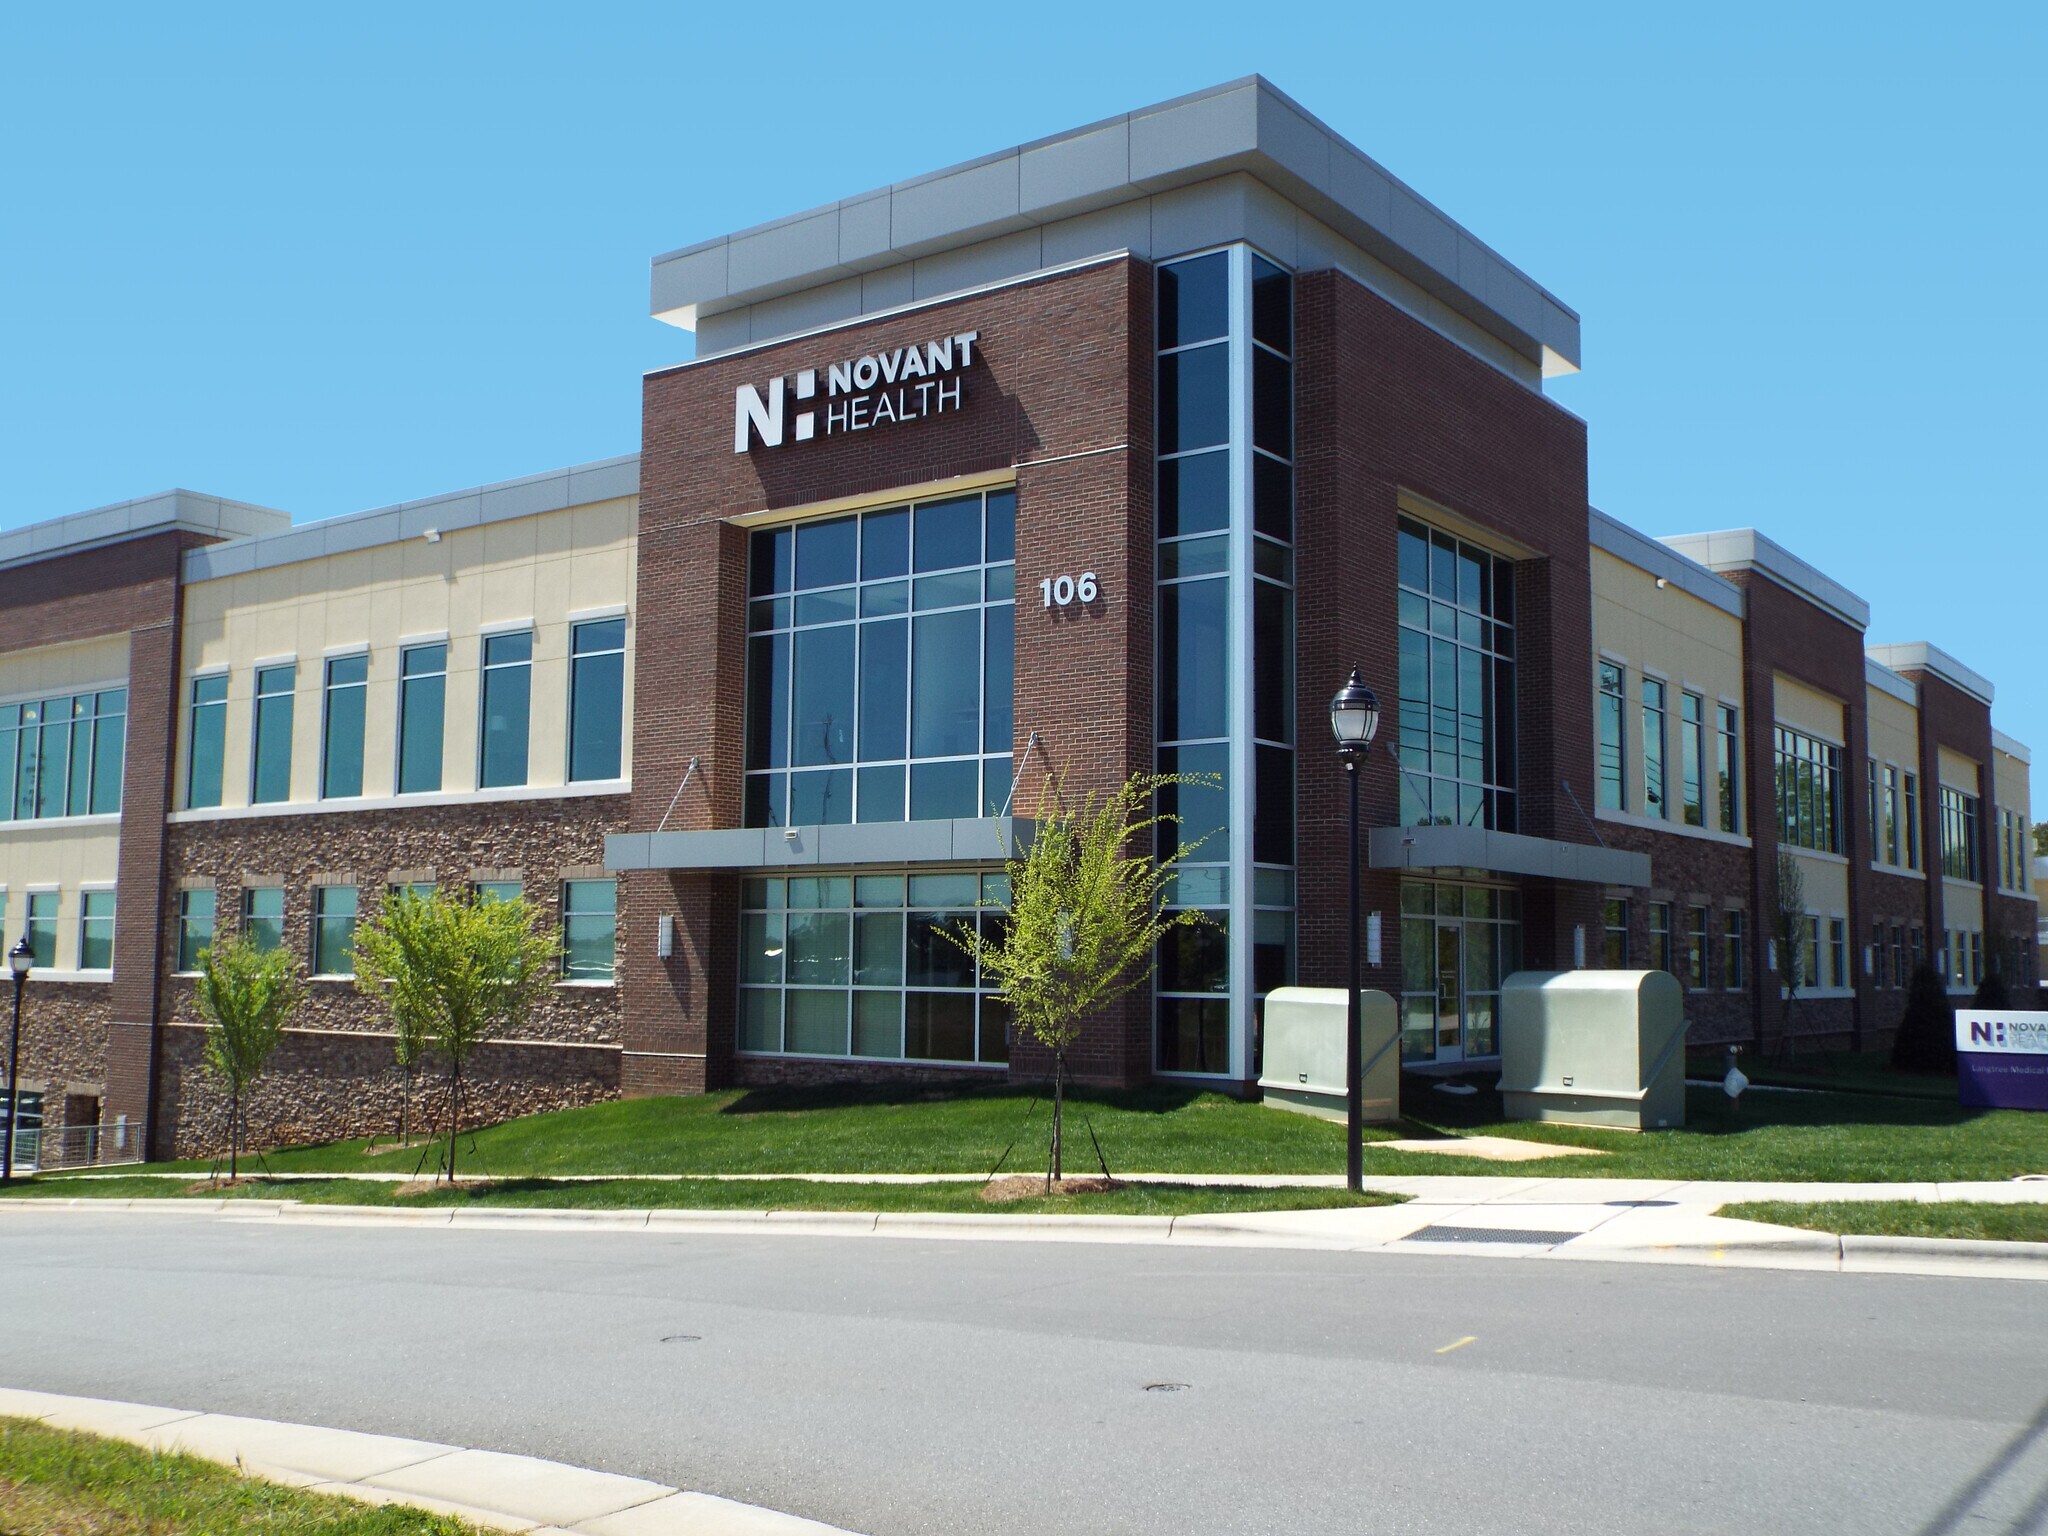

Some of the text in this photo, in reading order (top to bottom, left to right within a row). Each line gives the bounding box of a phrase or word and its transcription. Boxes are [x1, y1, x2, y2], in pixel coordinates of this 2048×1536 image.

[828, 330, 978, 397] NOVANT
[827, 376, 960, 435] HEALTH
[1039, 571, 1098, 608] 106
[2009, 1022, 2048, 1032] NOVA
[2010, 1065, 2045, 1074] Medical
